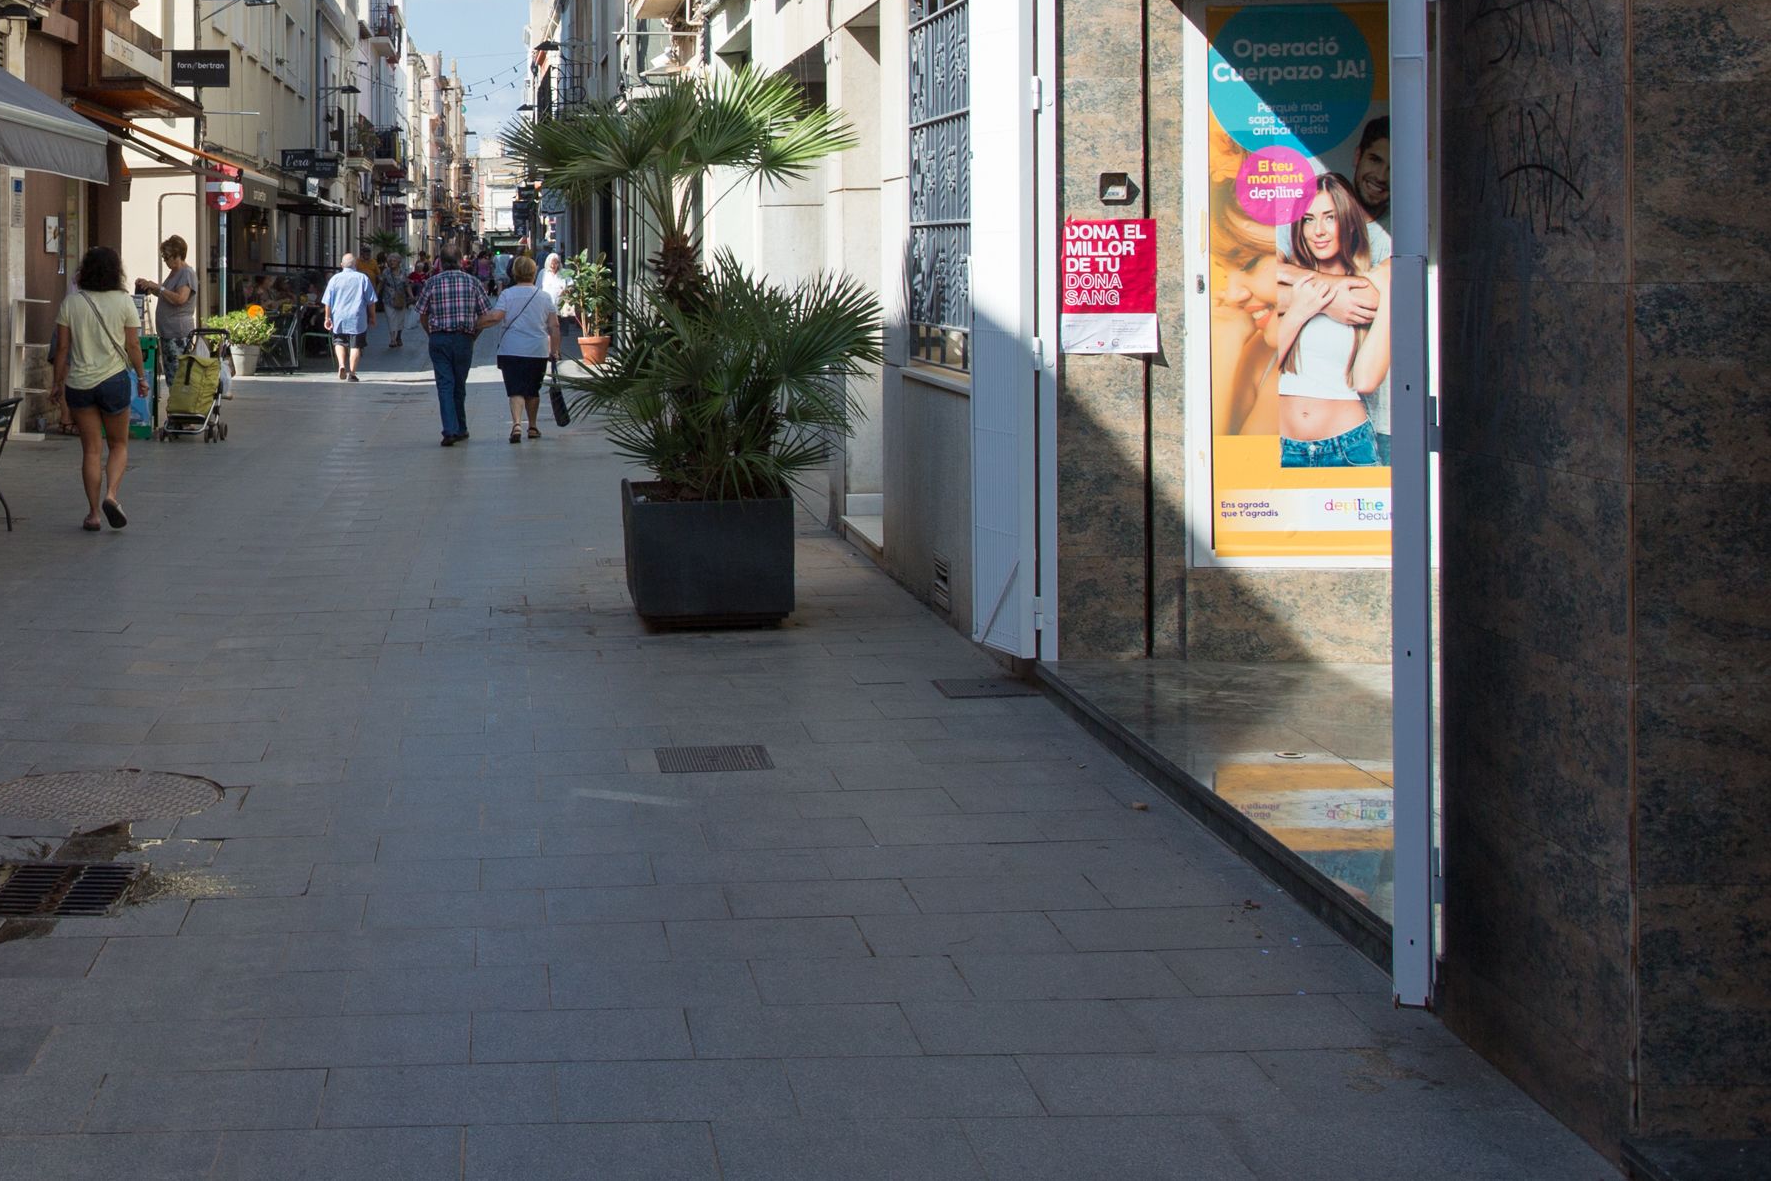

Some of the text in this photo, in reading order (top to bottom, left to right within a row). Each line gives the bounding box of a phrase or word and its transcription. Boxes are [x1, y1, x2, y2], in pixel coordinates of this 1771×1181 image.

[1233, 36, 1340, 63] Operació
[1212, 59, 1367, 85] Cuerpazo JA!
[1257, 101, 1323, 115] Perquè mai
[1248, 113, 1330, 126] saps quan pot
[1253, 124, 1329, 136] arribar l'estiu
[1258, 160, 1293, 173] El teu
[1247, 173, 1304, 185] moment
[1249, 187, 1304, 201] depiline
[1065, 224, 1147, 239] DONA EL
[1066, 241, 1135, 256] MILLOR
[1066, 257, 1120, 272] DE TU
[1065, 273, 1123, 289] DONA
[1065, 289, 1120, 306] SANG
[1237, 501, 1270, 512] agrada
[1324, 499, 1384, 513] depiline
[1239, 509, 1279, 518] t'agradis
